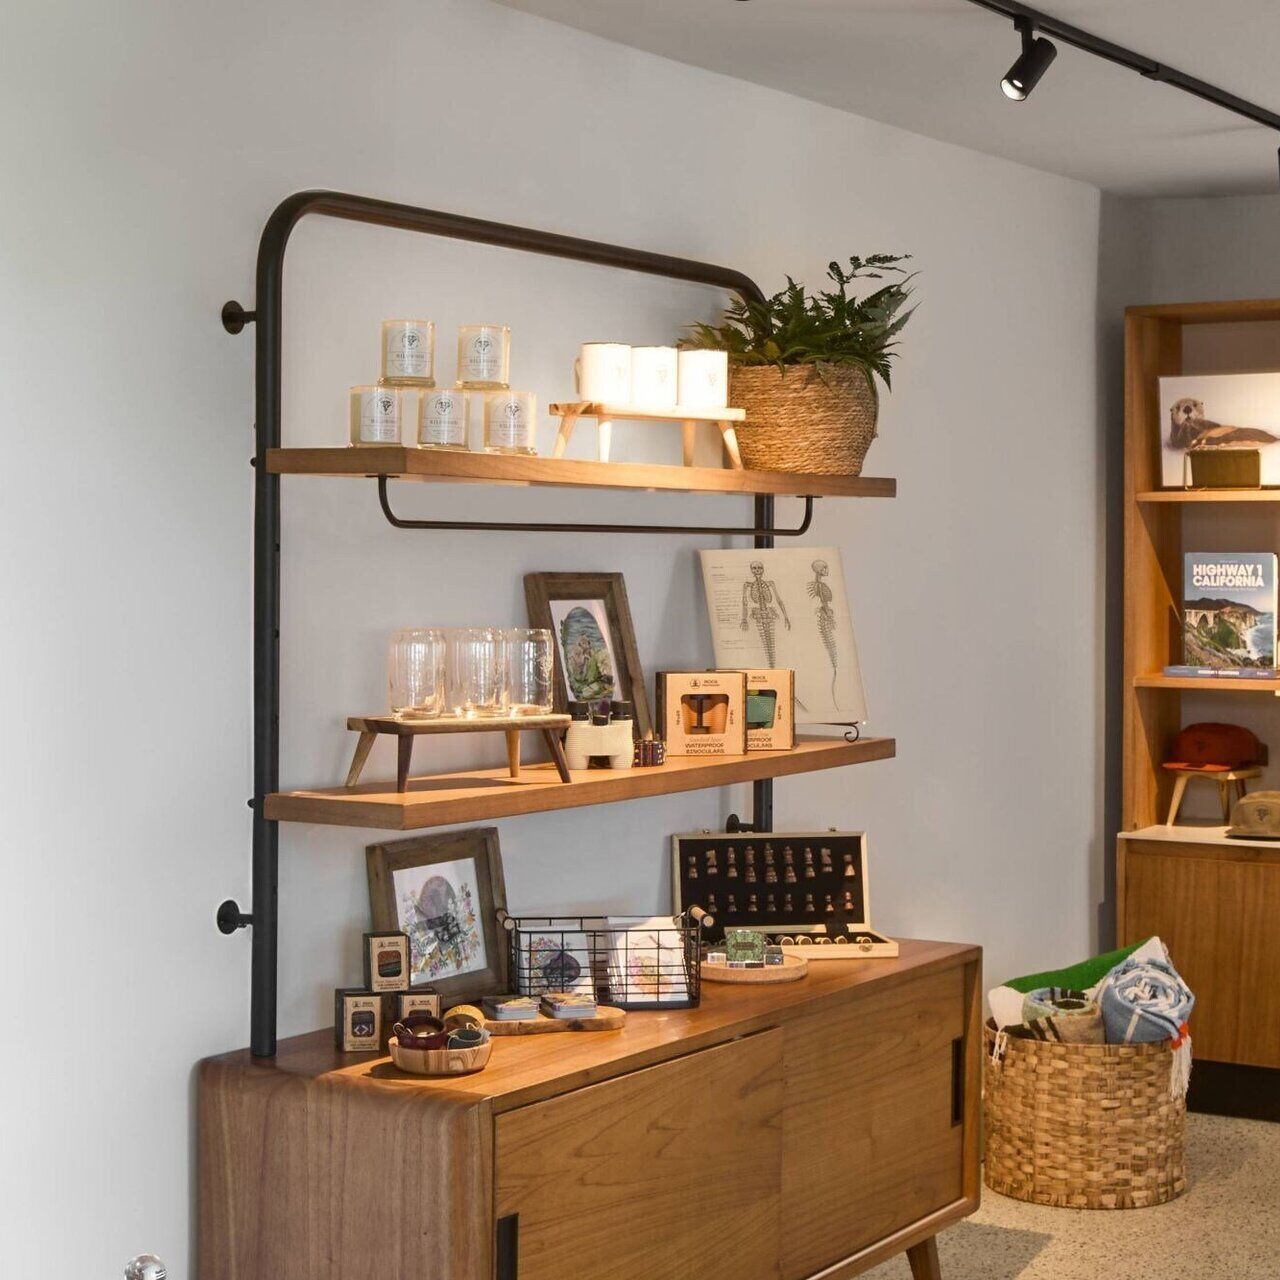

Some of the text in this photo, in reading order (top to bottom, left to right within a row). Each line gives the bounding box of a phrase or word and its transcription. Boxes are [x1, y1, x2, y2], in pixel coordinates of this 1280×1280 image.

[1192, 564, 1262, 576] HIGHWAY 1
[1192, 576, 1264, 587] CALIFORNIA
